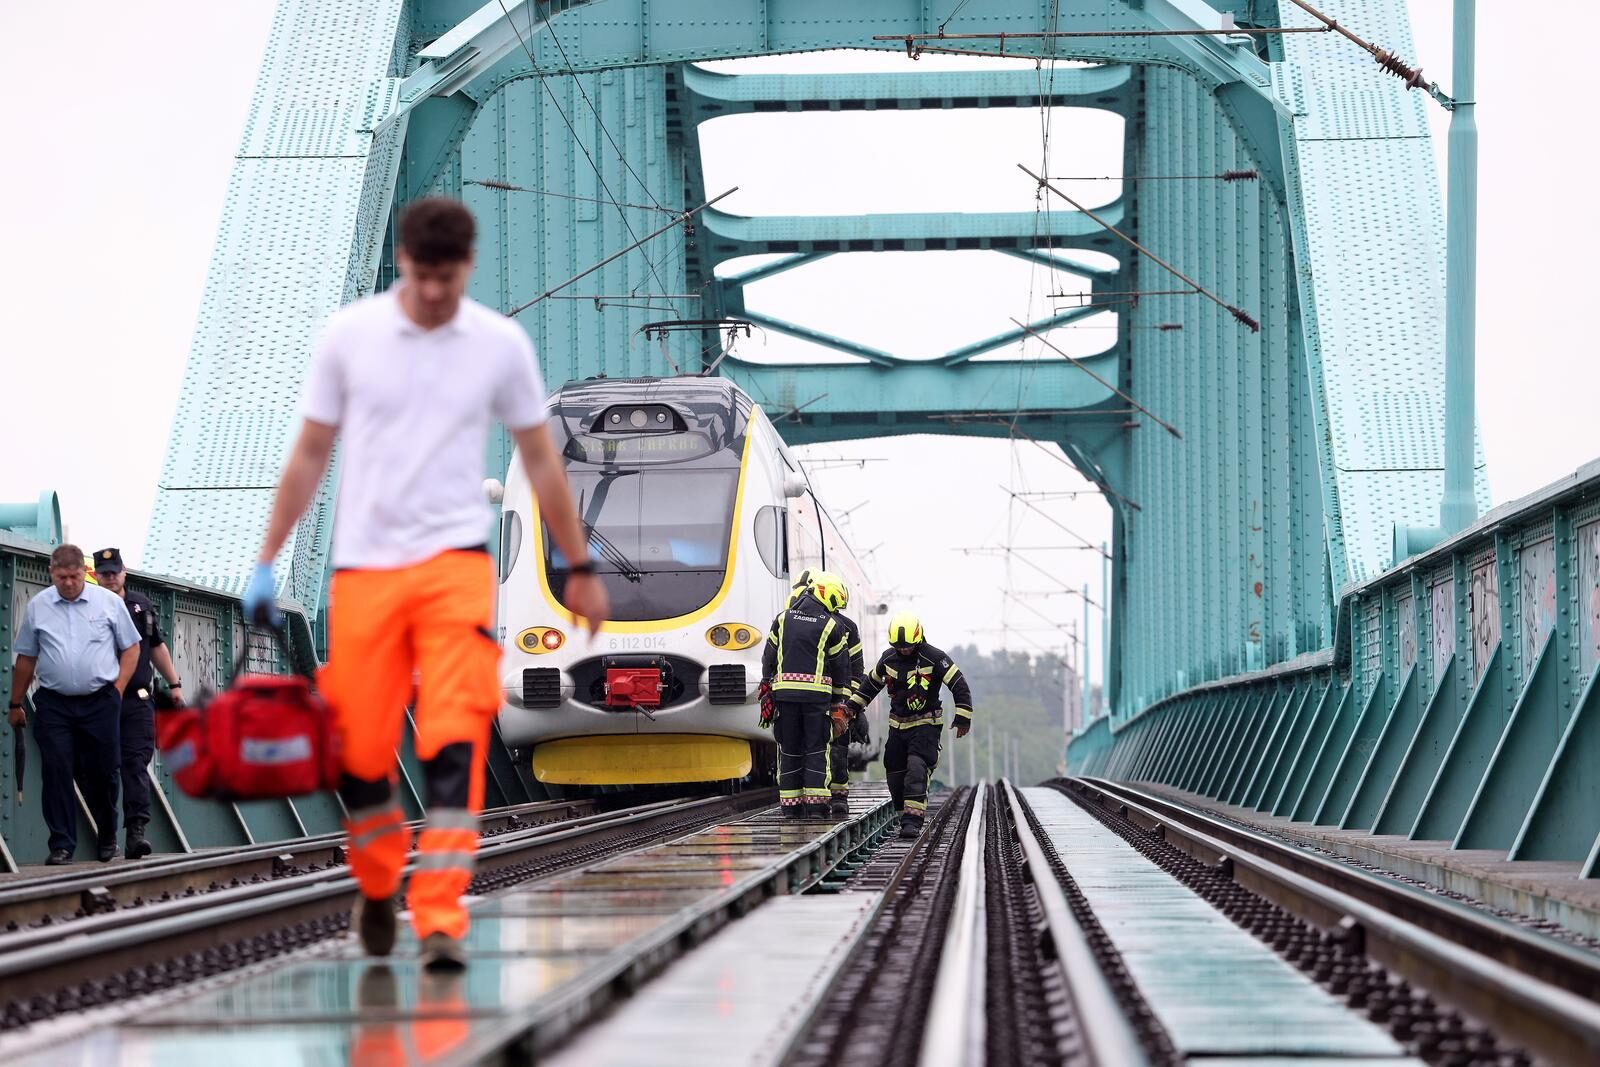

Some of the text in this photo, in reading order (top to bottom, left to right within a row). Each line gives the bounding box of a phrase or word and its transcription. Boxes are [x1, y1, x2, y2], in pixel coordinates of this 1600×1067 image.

[609, 636, 665, 649] 6 112 014
